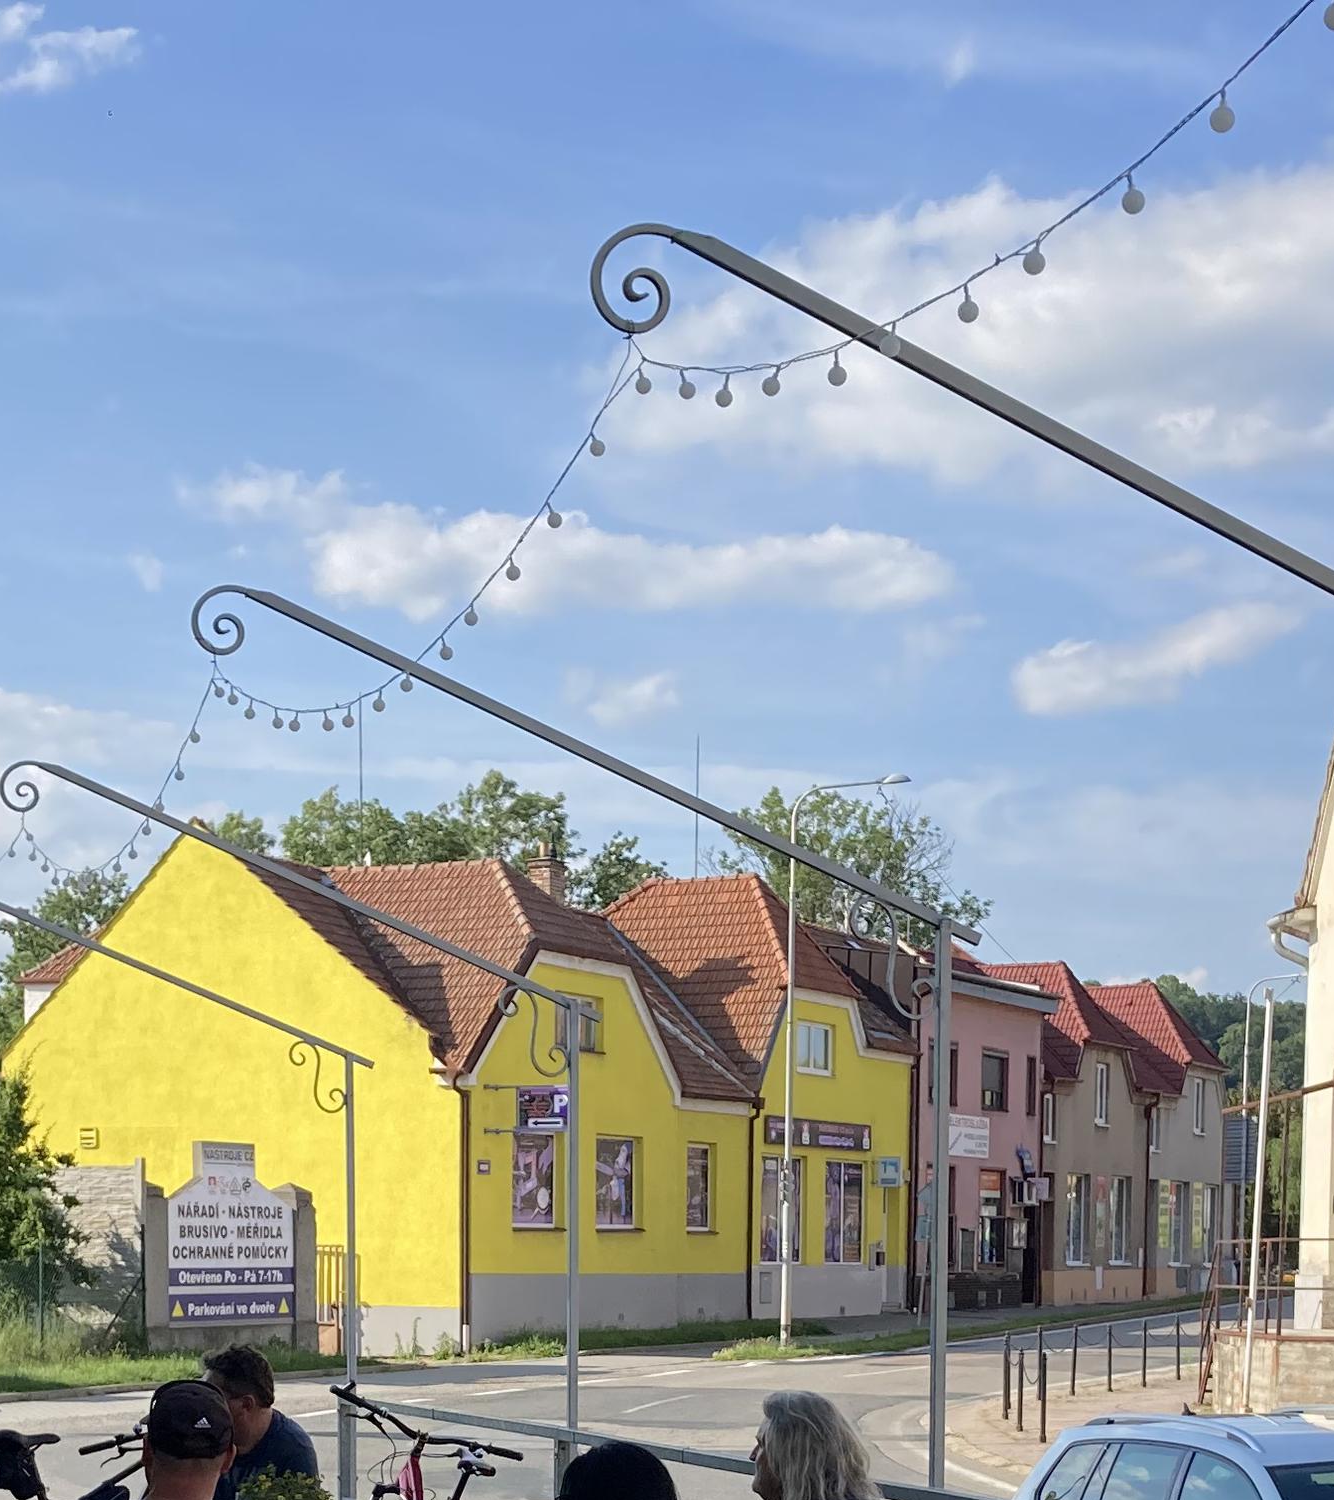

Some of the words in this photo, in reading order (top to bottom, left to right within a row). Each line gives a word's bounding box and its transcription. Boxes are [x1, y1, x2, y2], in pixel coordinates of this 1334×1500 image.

[553, 1094, 568, 1113] P
[177, 1201, 219, 1218] NÁŘADÍ
[228, 1202, 283, 1219] NÁSTROJE
[179, 1225, 227, 1238] BRUSIVO
[173, 1243, 234, 1259] OCHRANNÉ
[237, 1242, 288, 1259] POMŮCKY
[178, 1270, 223, 1284] Otevřeno
[224, 1271, 237, 1283] Po
[244, 1270, 257, 1282] Pá
[258, 1270, 283, 1282] 7-17h
[188, 1302, 234, 1316] Parkování
[237, 1305, 247, 1313] ve
[250, 1301, 275, 1314] dvoře
